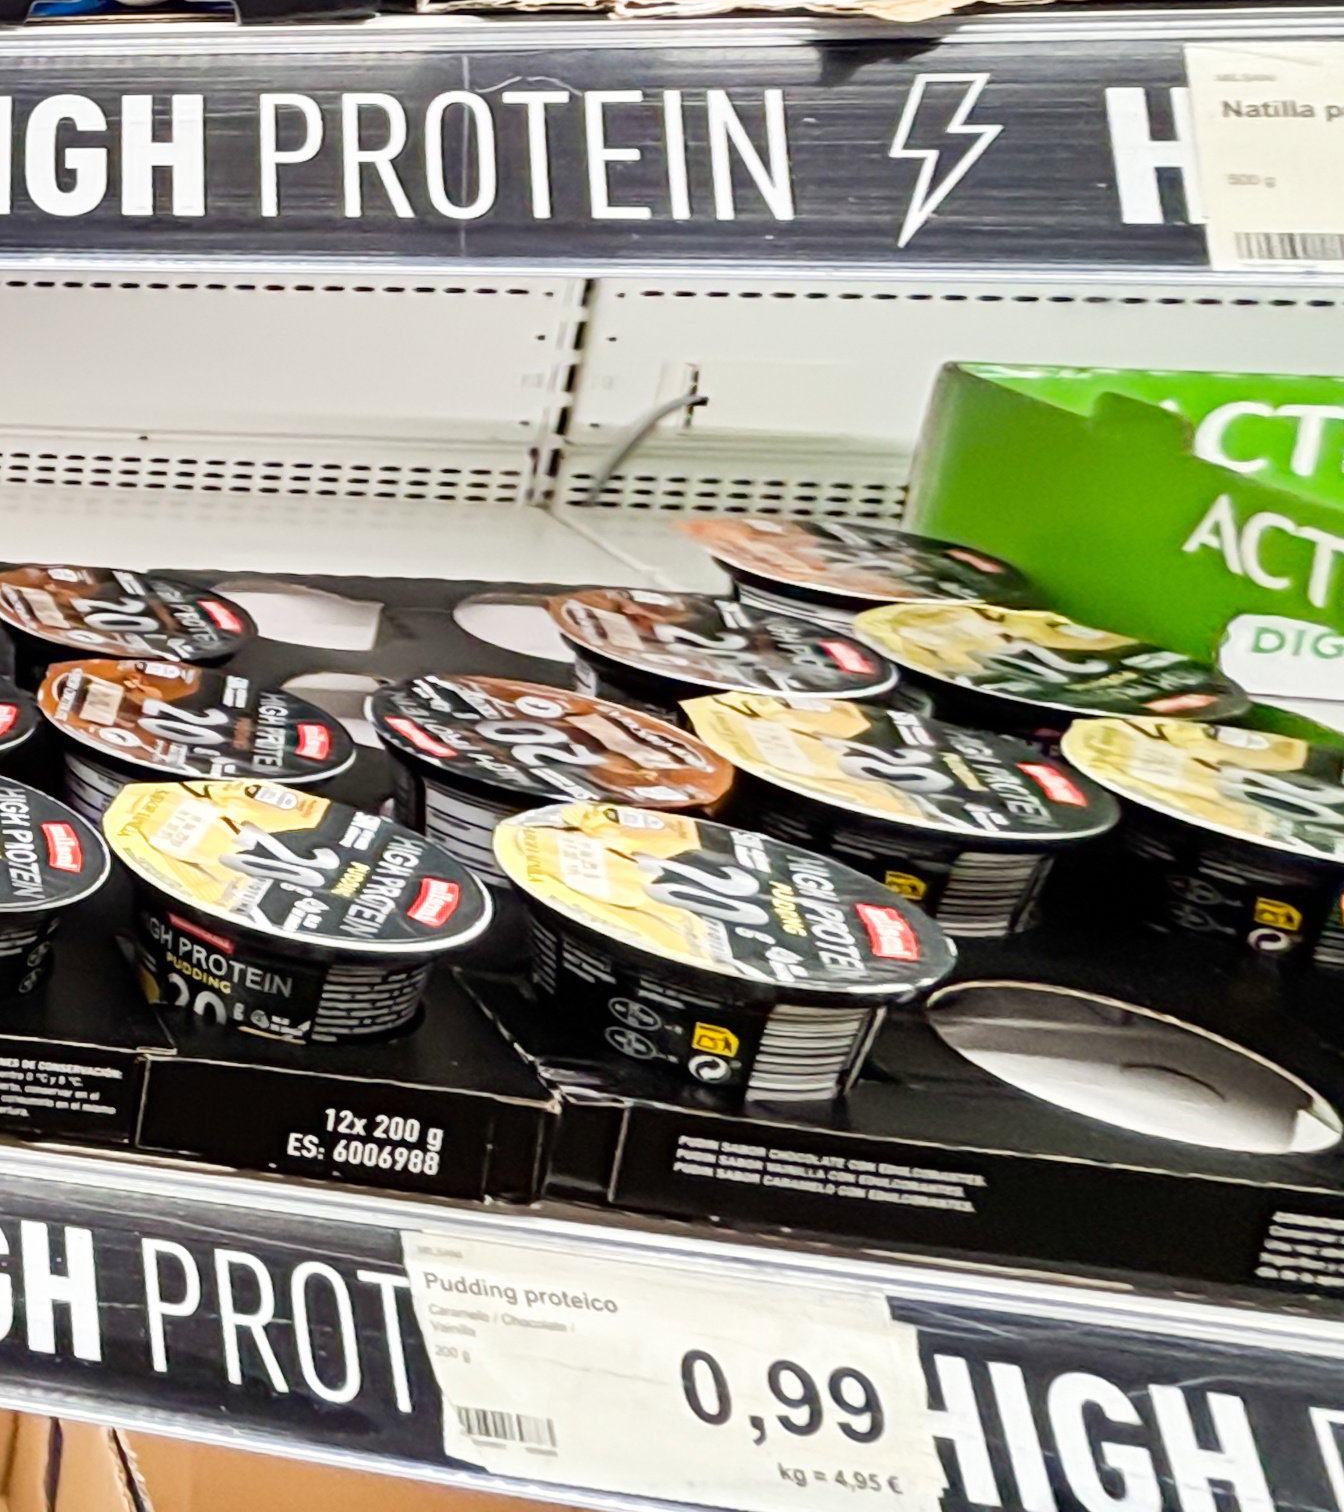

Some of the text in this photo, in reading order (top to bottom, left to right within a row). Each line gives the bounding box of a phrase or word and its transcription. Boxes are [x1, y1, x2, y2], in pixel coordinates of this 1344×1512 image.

[1221, 99, 1315, 119] Natilla
[259, 89, 796, 223] PROTEIN
[166, 951, 233, 995] PUDDING
[178, 936, 293, 999] PROTEIN
[376, 1113, 419, 1143] 200
[426, 1125, 444, 1150] g
[287, 1133, 440, 1176] ES: 6006988
[424, 1271, 619, 1315] Pudding proteico
[140, 1236, 415, 1414] PROT
[681, 1348, 885, 1445] 0,99
[925, 1353, 1280, 1512] HIGH
[778, 1462, 880, 1493] kg 4,95
